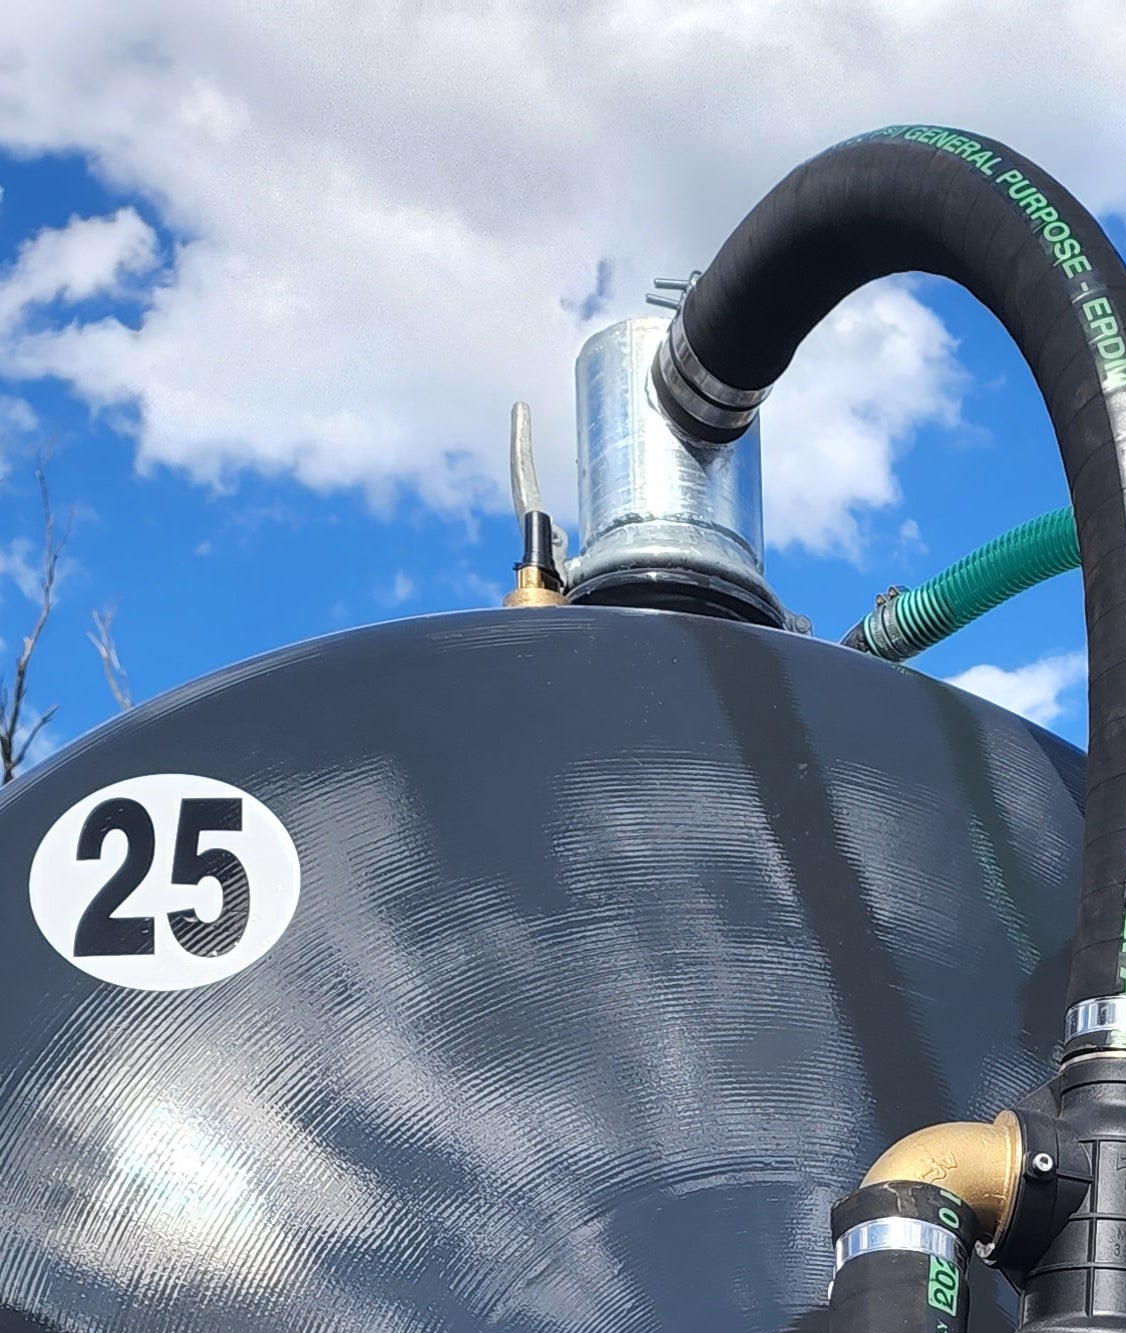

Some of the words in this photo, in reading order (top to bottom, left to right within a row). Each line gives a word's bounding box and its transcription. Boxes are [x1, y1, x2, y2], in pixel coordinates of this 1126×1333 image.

[903, 127, 1002, 176] GENERAL
[995, 169, 1093, 280] PURPOSE
[73, 797, 251, 959] 25
